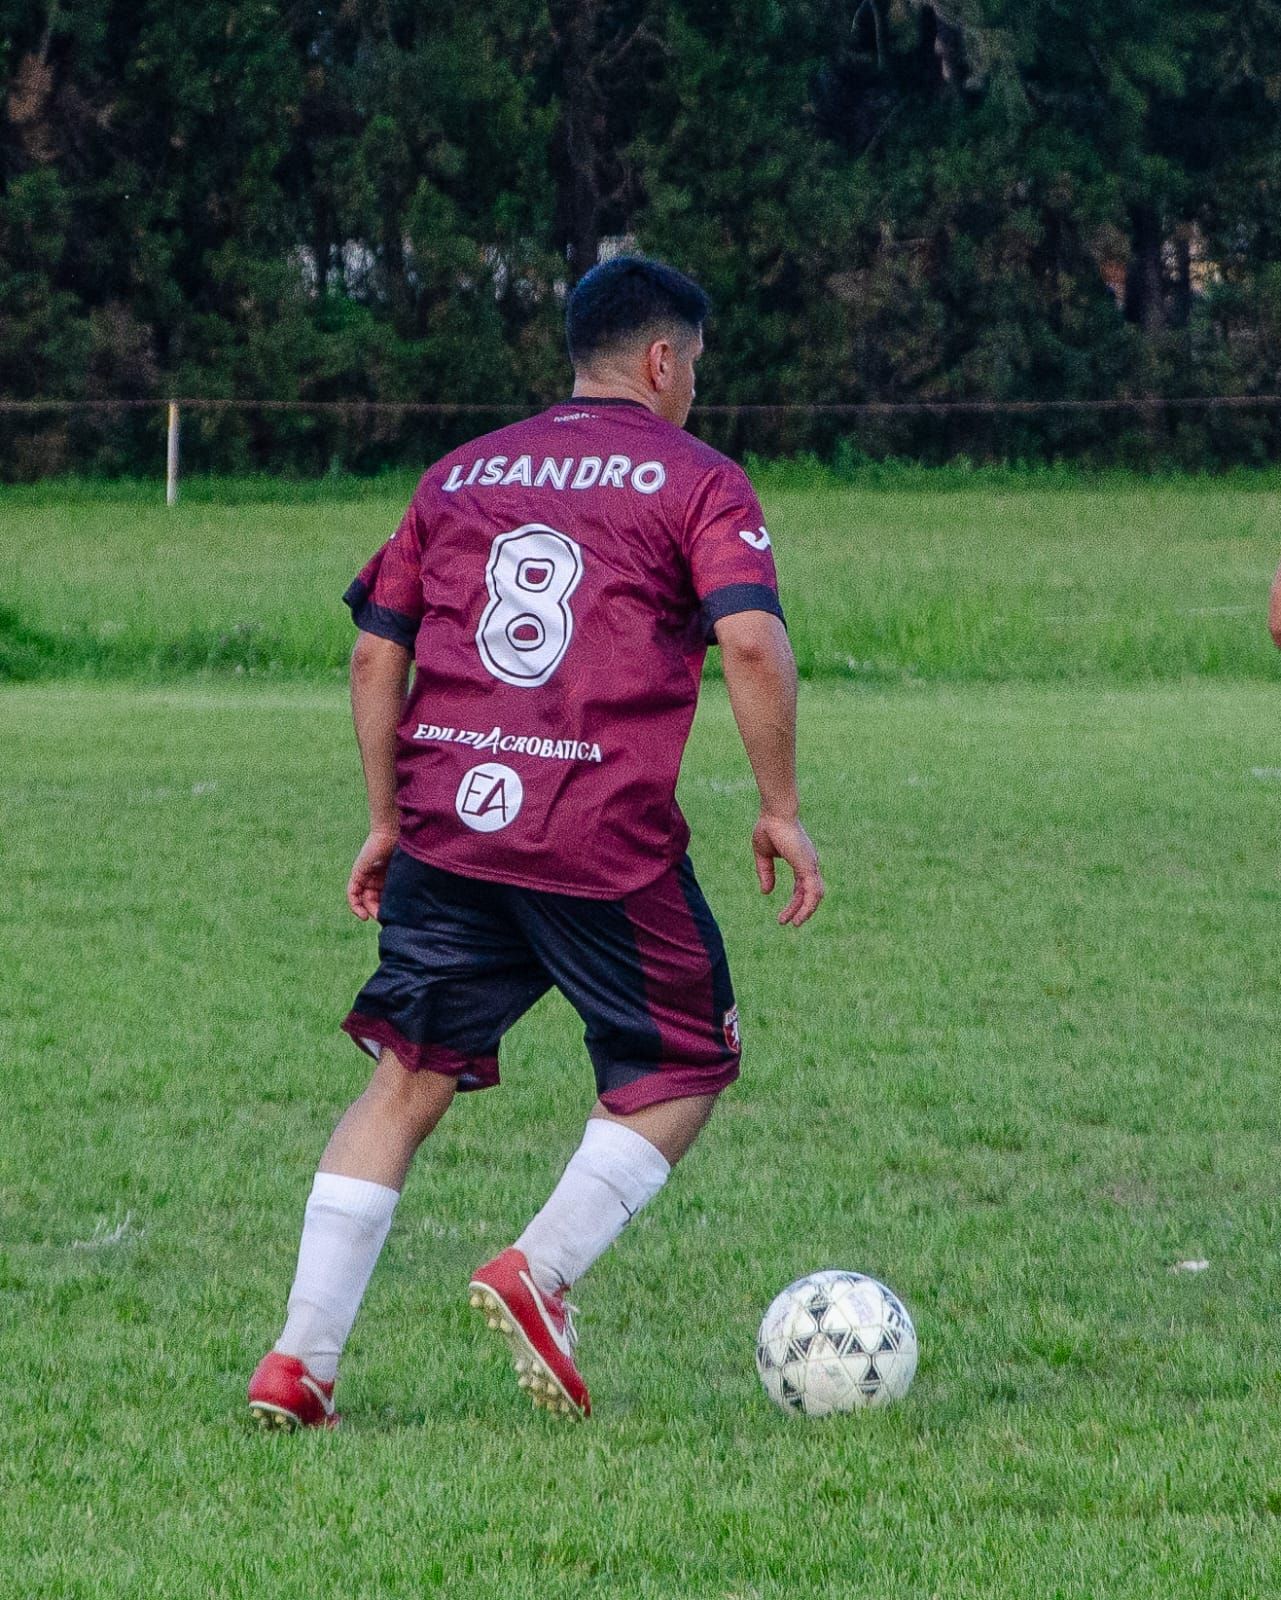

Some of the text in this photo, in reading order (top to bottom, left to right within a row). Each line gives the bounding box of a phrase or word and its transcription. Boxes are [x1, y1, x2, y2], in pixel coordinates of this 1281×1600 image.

[441, 455, 666, 494] LISANDRO
[475, 523, 583, 687] 8
[461, 771, 509, 822] EA
